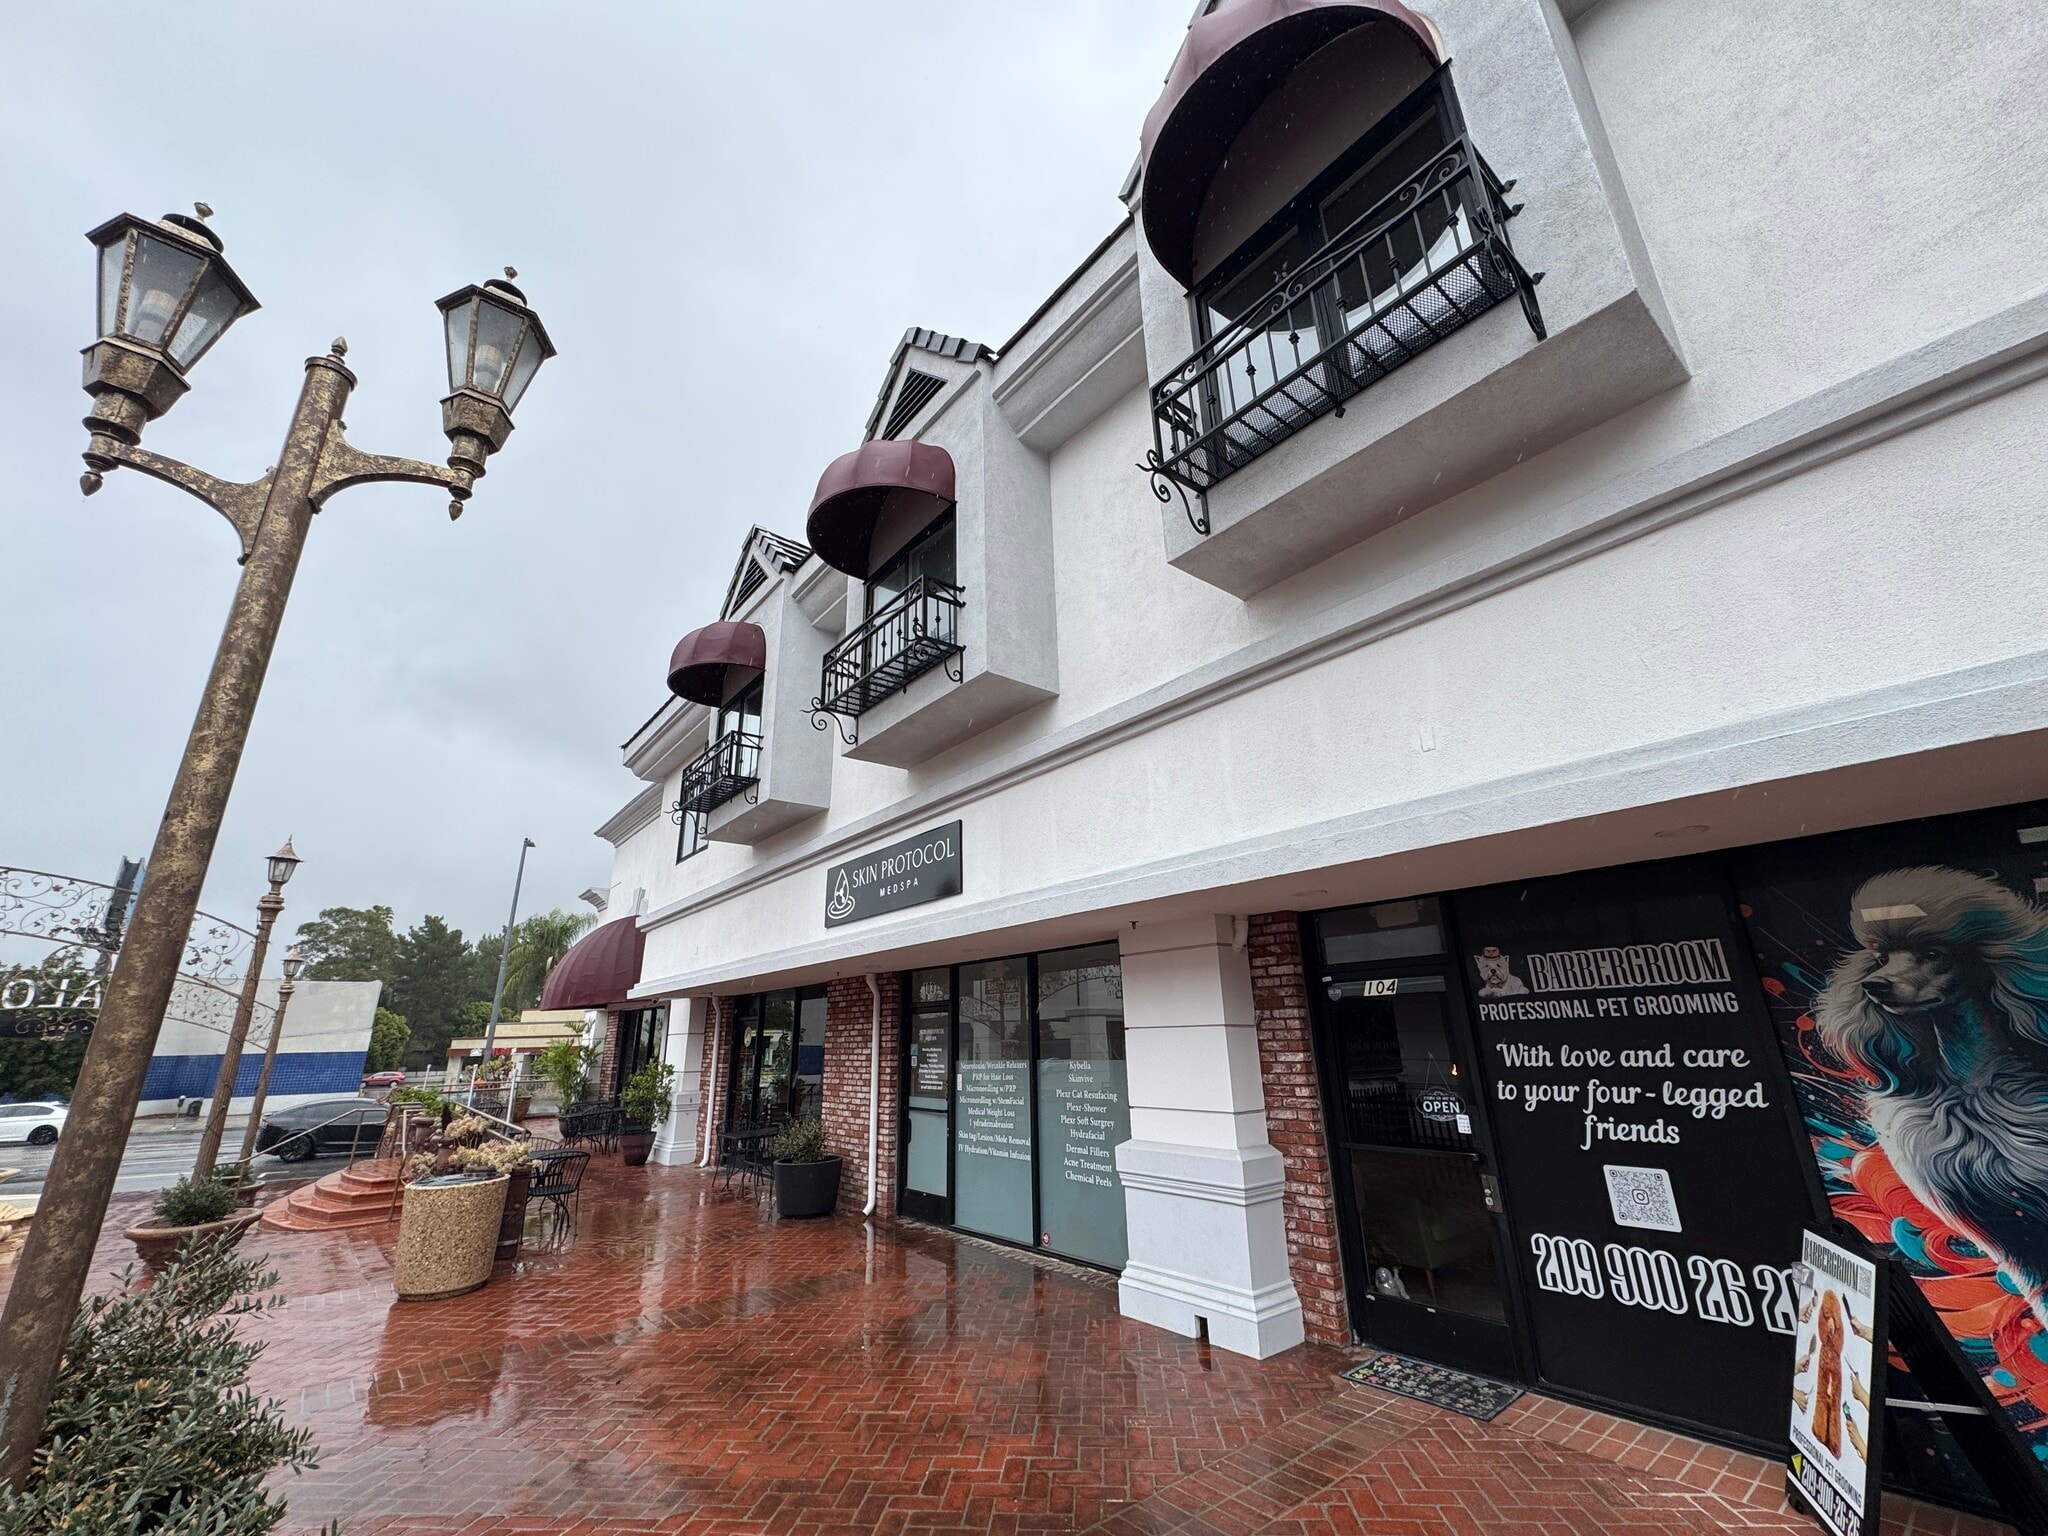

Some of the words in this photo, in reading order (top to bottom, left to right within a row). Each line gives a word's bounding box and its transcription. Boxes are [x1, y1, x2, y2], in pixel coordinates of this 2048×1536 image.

[852, 863, 878, 888] SKIN
[881, 838, 955, 880] PROTOCOL
[879, 878, 920, 897] MEDSPA
[1526, 938, 1732, 994] BARBERGROOM
[1367, 980, 1396, 995] 104
[1479, 998, 1595, 1023] PROFESSIONAL
[1597, 996, 1628, 1019] PET
[1633, 991, 1739, 1017] GROOMING
[1496, 1043, 1554, 1068] With
[1560, 1043, 1615, 1069] love
[1620, 1043, 1675, 1068] and
[1683, 1050, 1751, 1069] care
[1069, 1061, 1091, 1071] Kybella
[991, 1073, 1002, 1081] Hair
[1003, 1073, 1014, 1081] Loss
[1068, 1073, 1094, 1083] Skinvive
[1072, 1090, 1083, 1099] Cat
[1496, 1079, 1517, 1102] to
[1524, 1081, 1580, 1112] your
[967, 1107, 986, 1115] Medical
[986, 1108, 1003, 1118] Weight
[1004, 1109, 1015, 1117] Loss
[1423, 1101, 1460, 1114] OPEN
[1060, 1114, 1076, 1124] Plexr
[1077, 1116, 1089, 1125] Soft
[958, 1130, 968, 1139] Skin
[1008, 1136, 1031, 1146] Removal
[1070, 1129, 1106, 1140] Hydrafacial
[1580, 1115, 1681, 1151] friends
[958, 1144, 964, 1152] IV
[1010, 1150, 1031, 1161] Infusion
[1066, 1143, 1089, 1155] Dermal
[1089, 1146, 1110, 1158] Fillers
[1063, 1157, 1079, 1168] Acne
[1079, 1158, 1112, 1173] Treatment
[1065, 1170, 1095, 1184] Chemical
[1095, 1175, 1112, 1188] Peels
[1531, 1233, 1605, 1300] 209
[1604, 1245, 1688, 1315] 900
[1687, 1256, 1754, 1327] 26
[1792, 1425, 1825, 1468] PROFESSIONAL
[1824, 1458, 1835, 1477] PET
[1834, 1468, 1862, 1508] GROOMING
